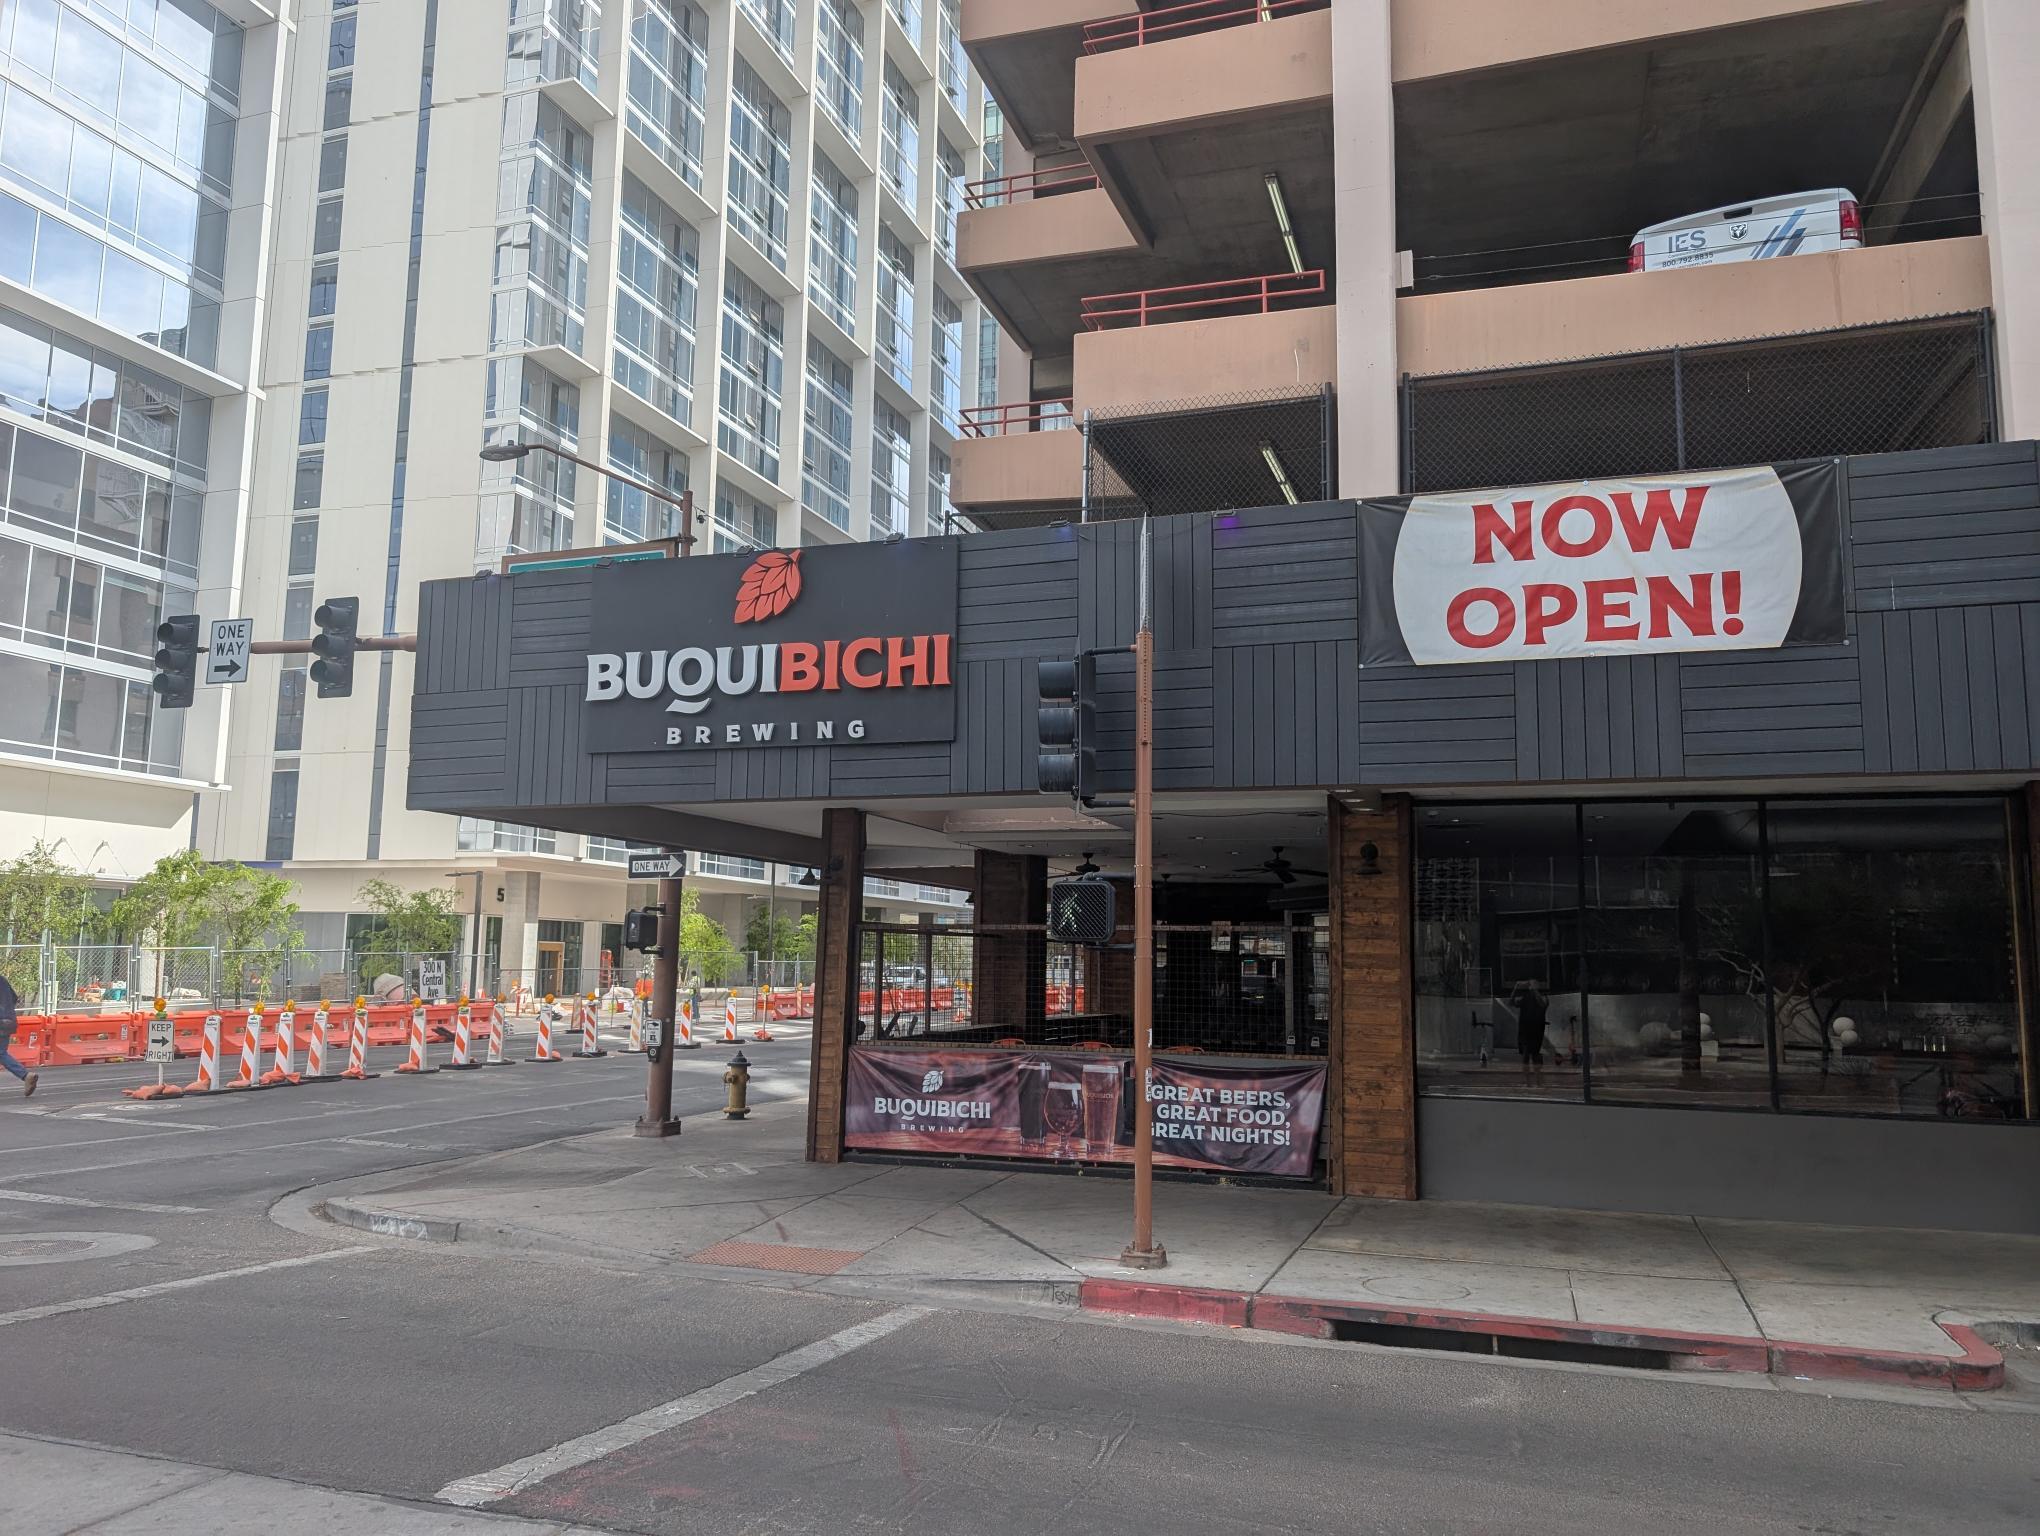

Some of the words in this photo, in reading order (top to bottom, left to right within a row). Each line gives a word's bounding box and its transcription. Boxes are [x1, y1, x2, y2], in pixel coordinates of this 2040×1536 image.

[1669, 230, 1706, 253] IES
[1472, 486, 1710, 565] NOW
[1446, 570, 1744, 649] OPEN!
[218, 624, 246, 640] ONE
[216, 641, 245, 657] WAY
[586, 633, 952, 713] BUQUIBICHI
[666, 720, 865, 745] BREWING
[634, 861, 651, 872] ONE
[653, 860, 670, 871] WAY
[423, 961, 436, 973] 300
[437, 961, 442, 973] N
[422, 974, 444, 986] Central
[427, 987, 439, 998] Ave
[151, 1023, 172, 1032] KEEP
[148, 1050, 173, 1062] RIGHT
[1151, 1084, 1215, 1103] GREAT
[1219, 1089, 1291, 1110] BEERS,
[874, 1097, 991, 1121] BUQUIBICHI
[1156, 1103, 1221, 1123] GREAT
[1226, 1108, 1291, 1129] FOOD,
[901, 1123, 964, 1134] BREWING
[1151, 1122, 1206, 1141] REAT
[1211, 1126, 1291, 1147] NIGHTS!
